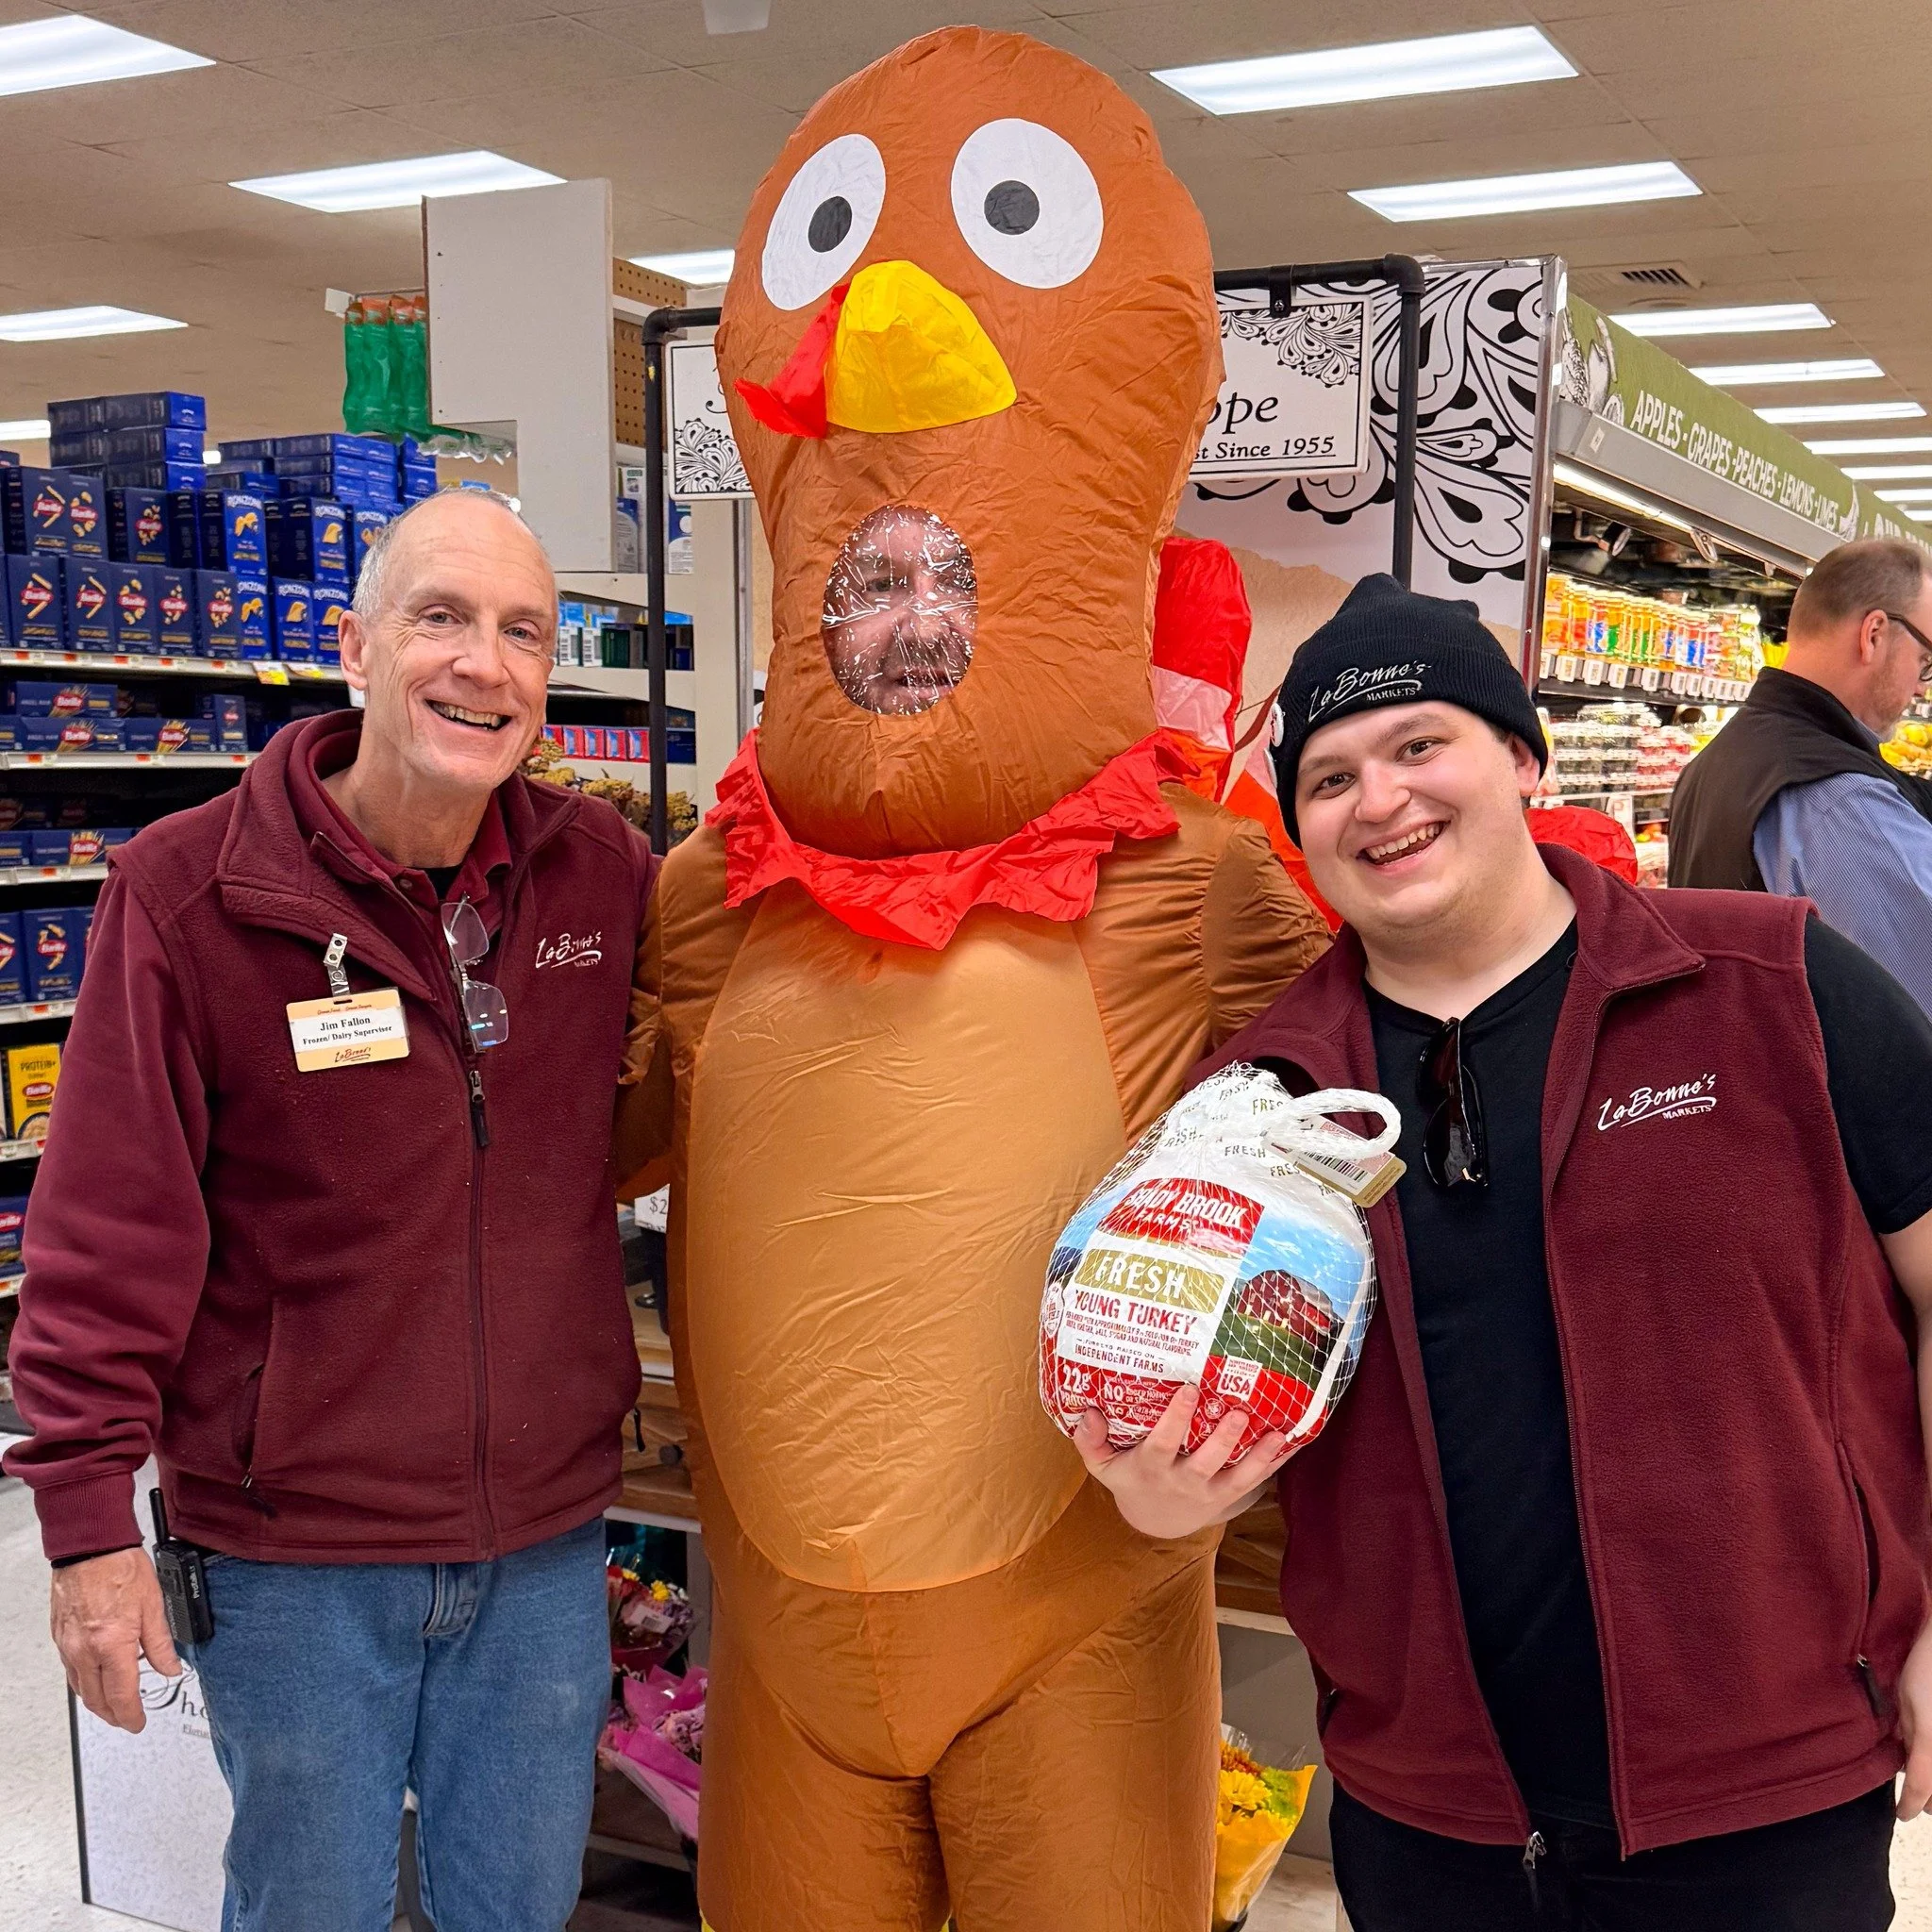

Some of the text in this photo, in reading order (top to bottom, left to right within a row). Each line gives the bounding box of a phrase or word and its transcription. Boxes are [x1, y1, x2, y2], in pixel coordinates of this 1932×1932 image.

[1215, 442, 1271, 458] Since
[1282, 436, 1335, 456] 1955
[1630, 390, 1839, 530] APPLES GRAPES PEACHES LEMONS LIMES
[237, 581, 267, 595] ONZONI
[1308, 661, 1428, 724] LaBonne's
[1367, 687, 1416, 701] MARKETS
[320, 1016, 371, 1031] Jim Fallon
[332, 1032, 352, 1041] Dairy
[354, 1025, 392, 1038] Supervisor
[1597, 1074, 1716, 1131] LaBonne's
[1662, 1105, 1712, 1120] MARKETS
[1224, 1145, 1266, 1158] FRESH
[1135, 1209, 1192, 1231] FARMS
[1174, 1190, 1248, 1228] BROOK
[1095, 1256, 1187, 1299] FRESH
[1074, 1290, 1122, 1319] YOUNG
[1127, 1302, 1198, 1336] TURKEY
[1074, 1343, 1164, 1374] INDEPENDENT FARMS
[1062, 1364, 1091, 1393] 22g
[1221, 1374, 1251, 1396] USA
[1104, 1384, 1124, 1402] NO
